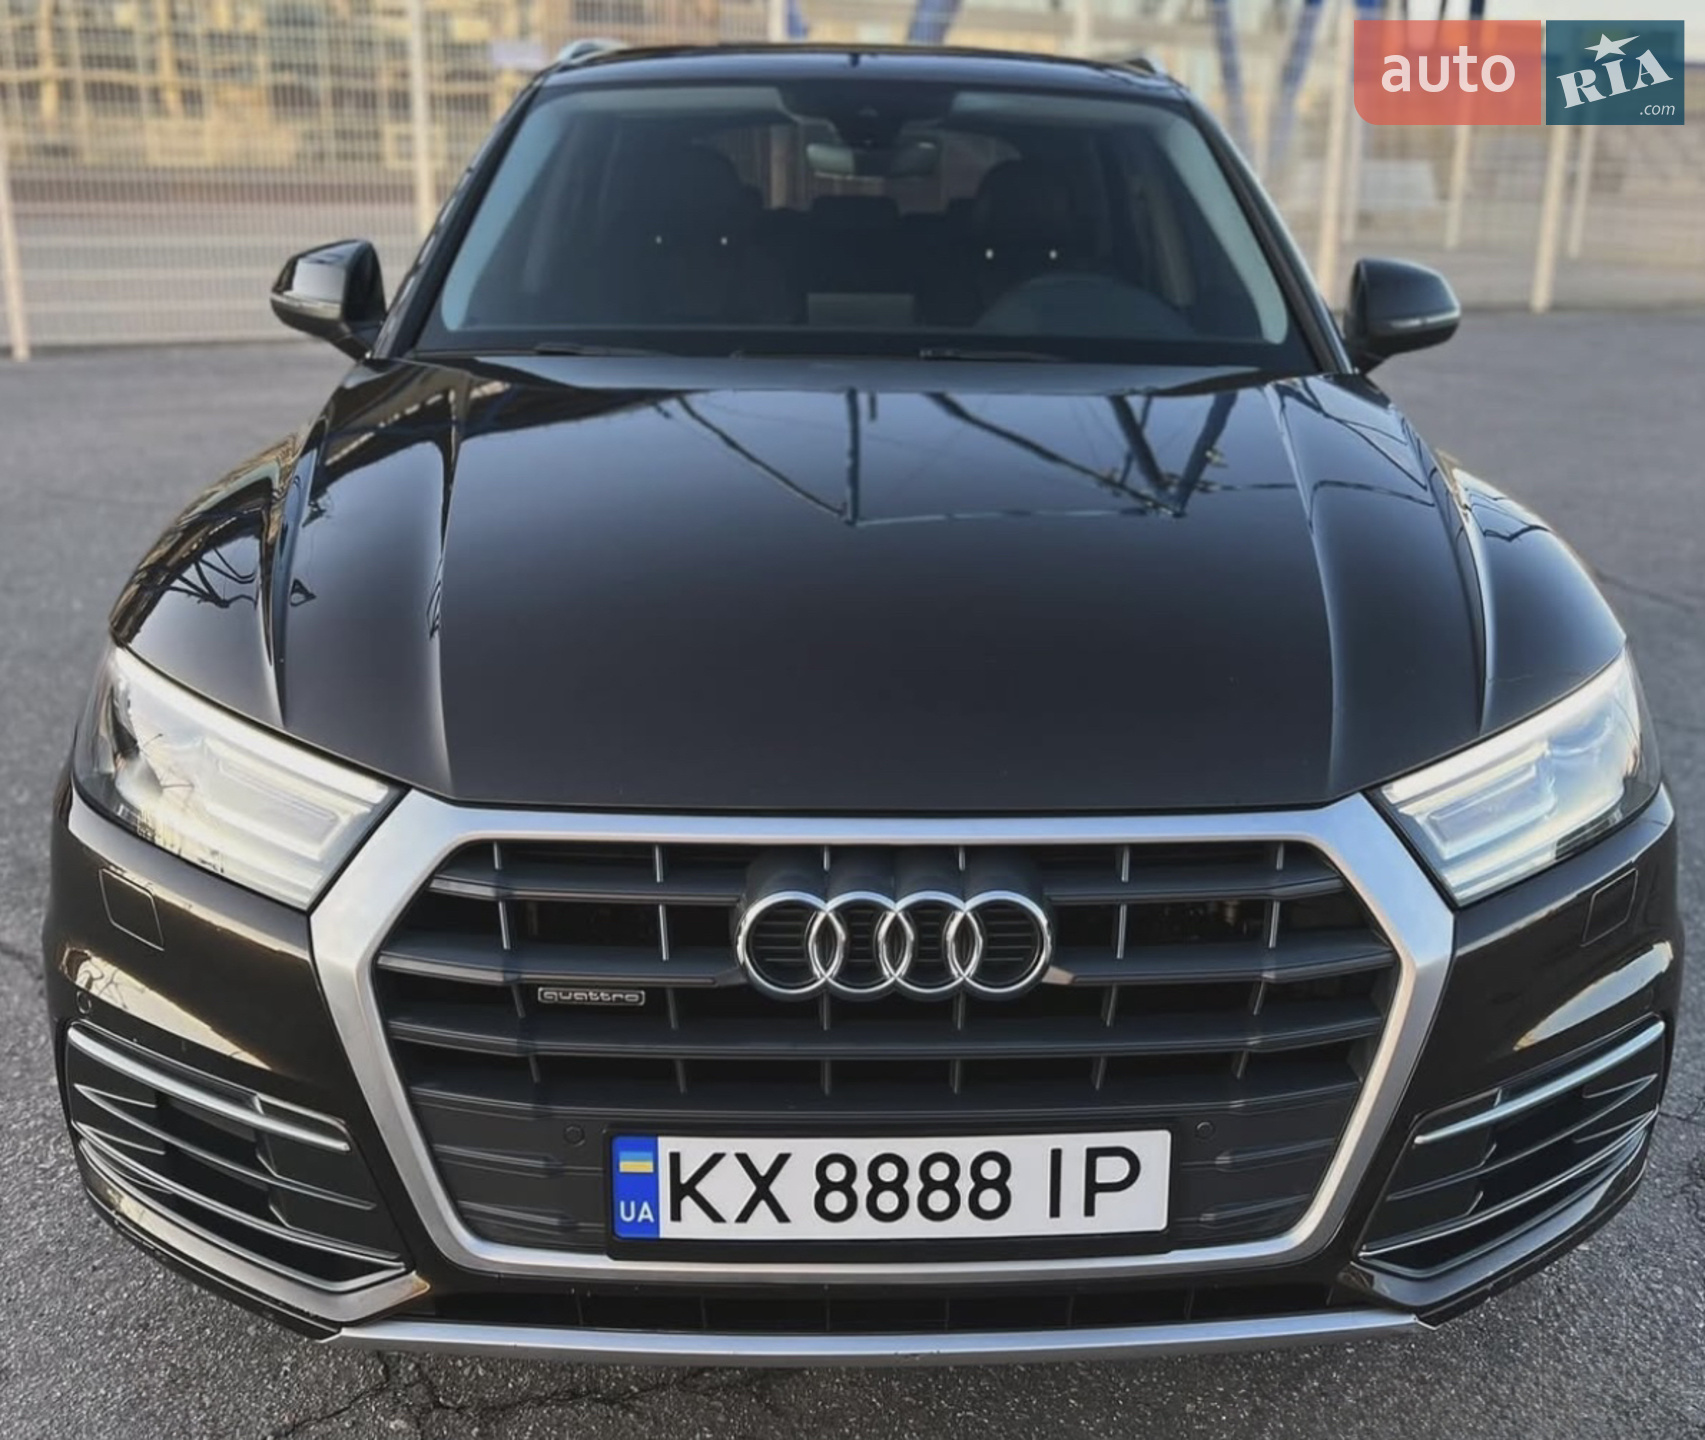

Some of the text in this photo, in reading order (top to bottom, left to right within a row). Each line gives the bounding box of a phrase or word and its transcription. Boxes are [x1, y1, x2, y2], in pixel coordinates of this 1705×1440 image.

[543, 990, 640, 1002] quattro
[668, 1145, 1142, 1224] KX 8888 IP
[619, 1200, 655, 1223] UA
